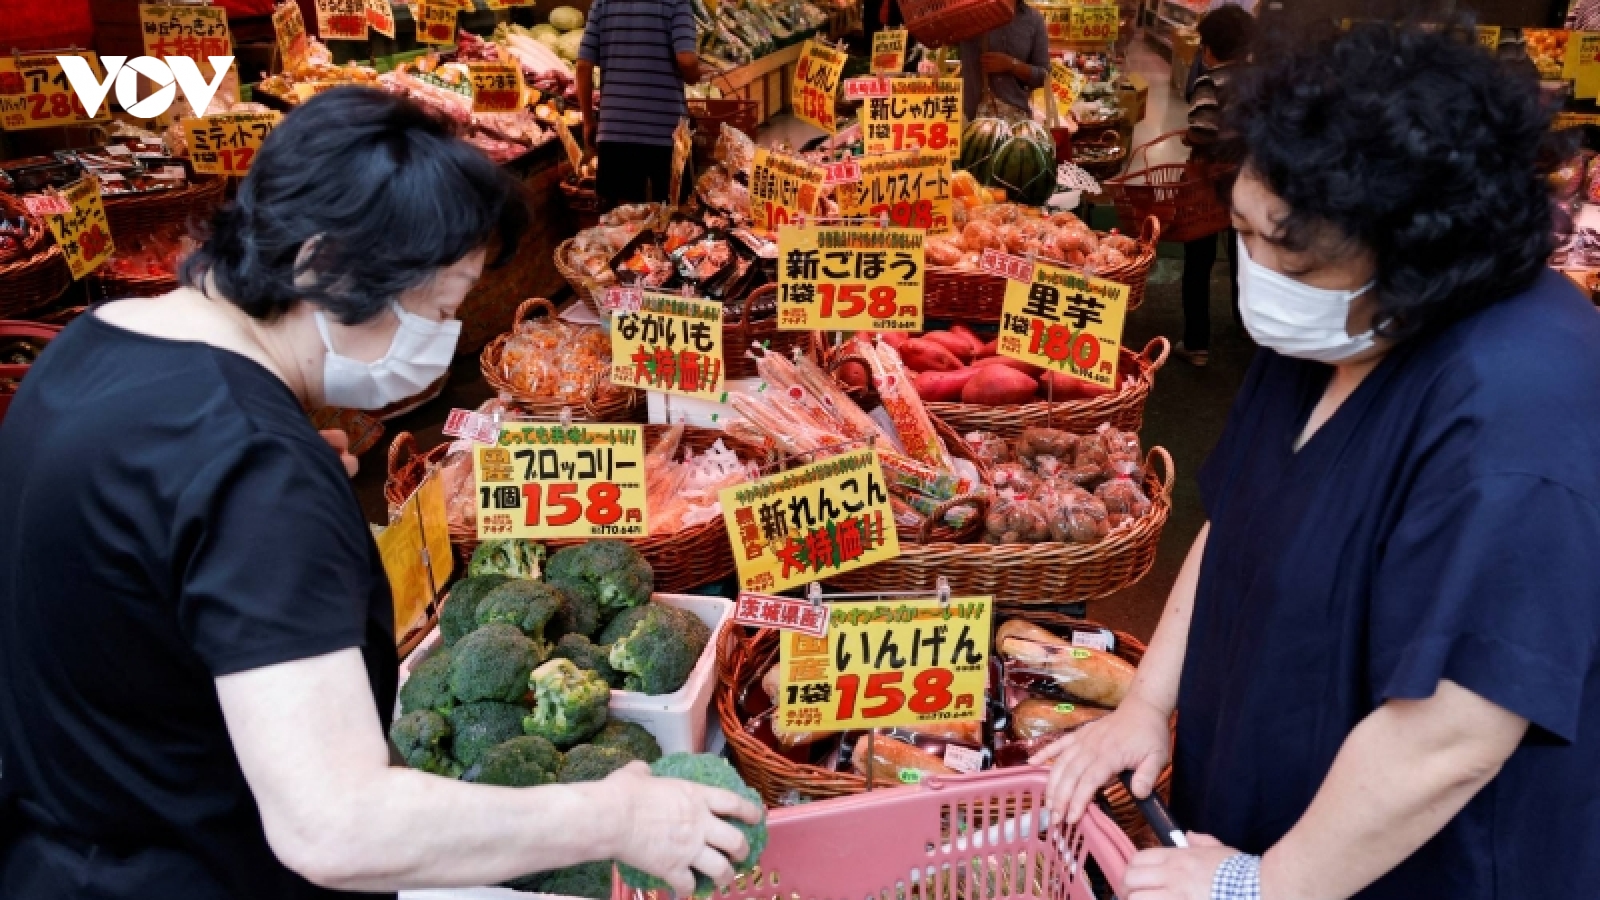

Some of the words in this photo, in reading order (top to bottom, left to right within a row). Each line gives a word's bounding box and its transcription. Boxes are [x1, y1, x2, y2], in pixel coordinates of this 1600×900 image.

[869, 95, 959, 120] 新じゃが芋
[858, 168, 949, 206] シルクスイート
[786, 249, 918, 280] 新ごぼう
[781, 283, 815, 304] 1袋
[1021, 283, 1105, 329] 里芋
[618, 313, 714, 353] ながいも
[514, 447, 637, 481] ブロッコリー
[480, 485, 521, 509] 1個
[758, 472, 888, 541] 新れんこん
[741, 596, 824, 632] 茨城県産
[835, 624, 984, 673] いんげん
[786, 682, 832, 705] 1袋
